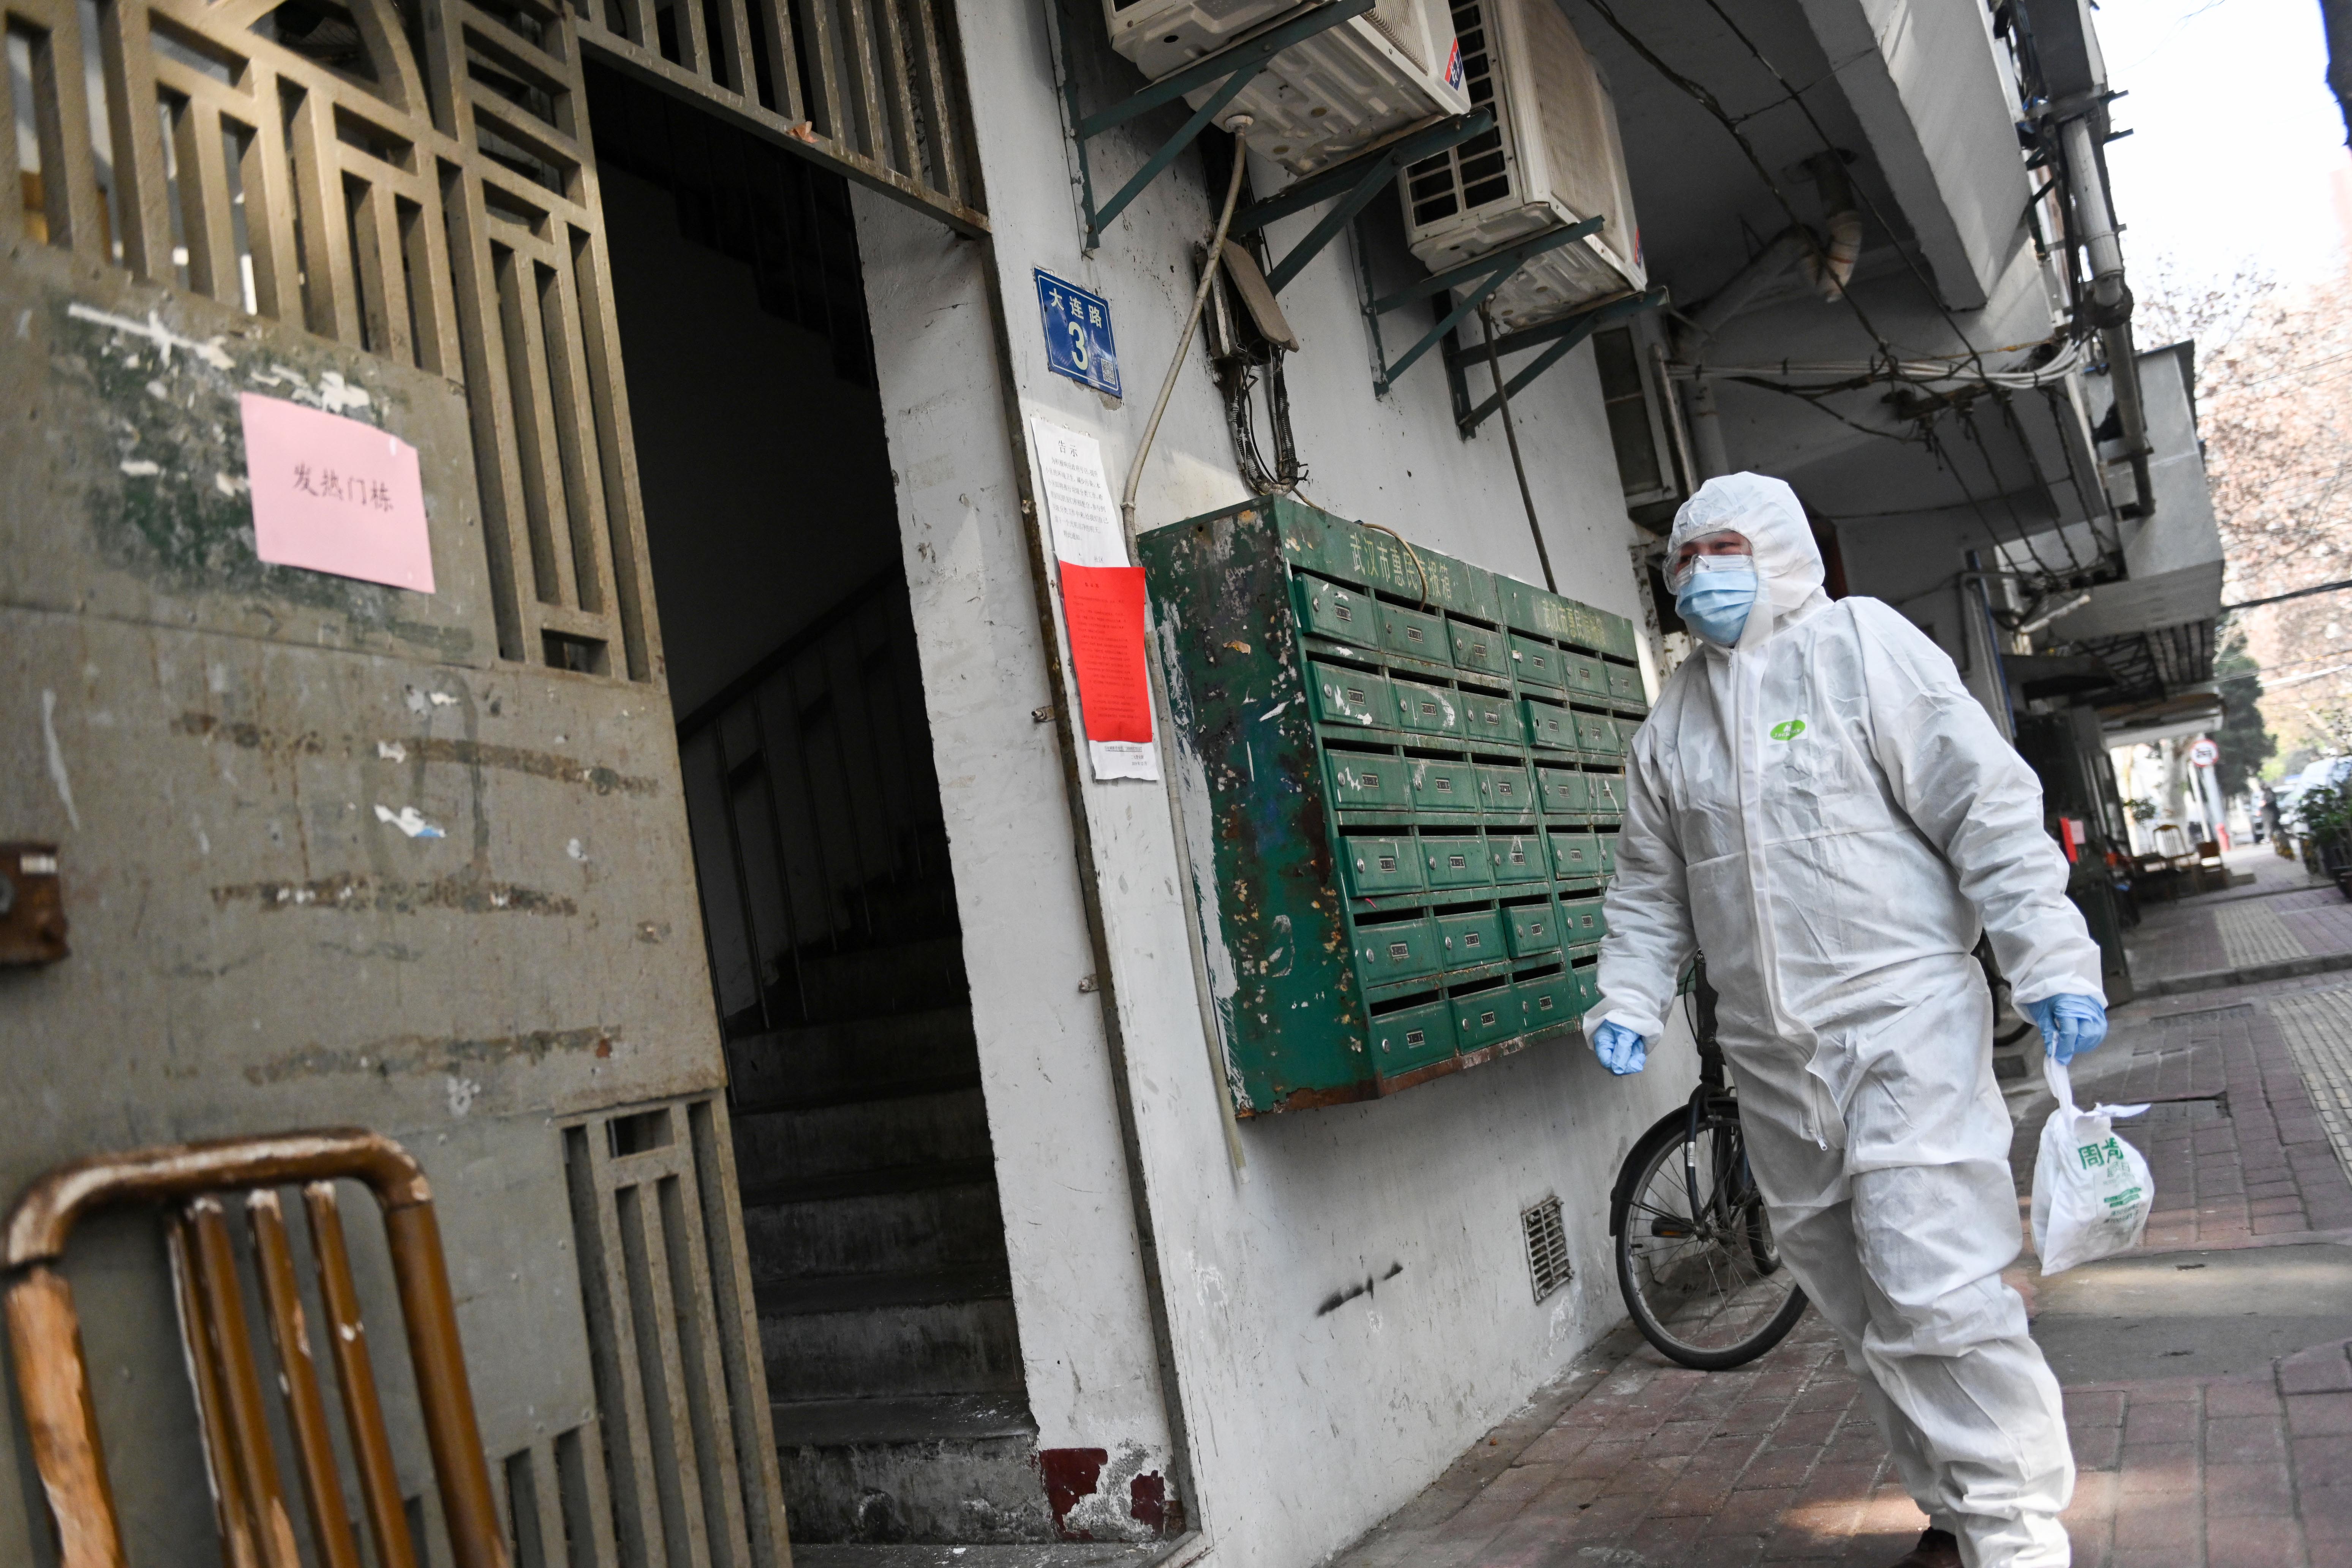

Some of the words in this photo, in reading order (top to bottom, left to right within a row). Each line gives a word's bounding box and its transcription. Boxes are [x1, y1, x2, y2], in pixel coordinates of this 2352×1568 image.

[1049, 288, 1102, 329] 大连路
[1069, 321, 1089, 370] 3
[1058, 440, 1078, 457] 告示
[293, 461, 394, 512] 发热门栋
